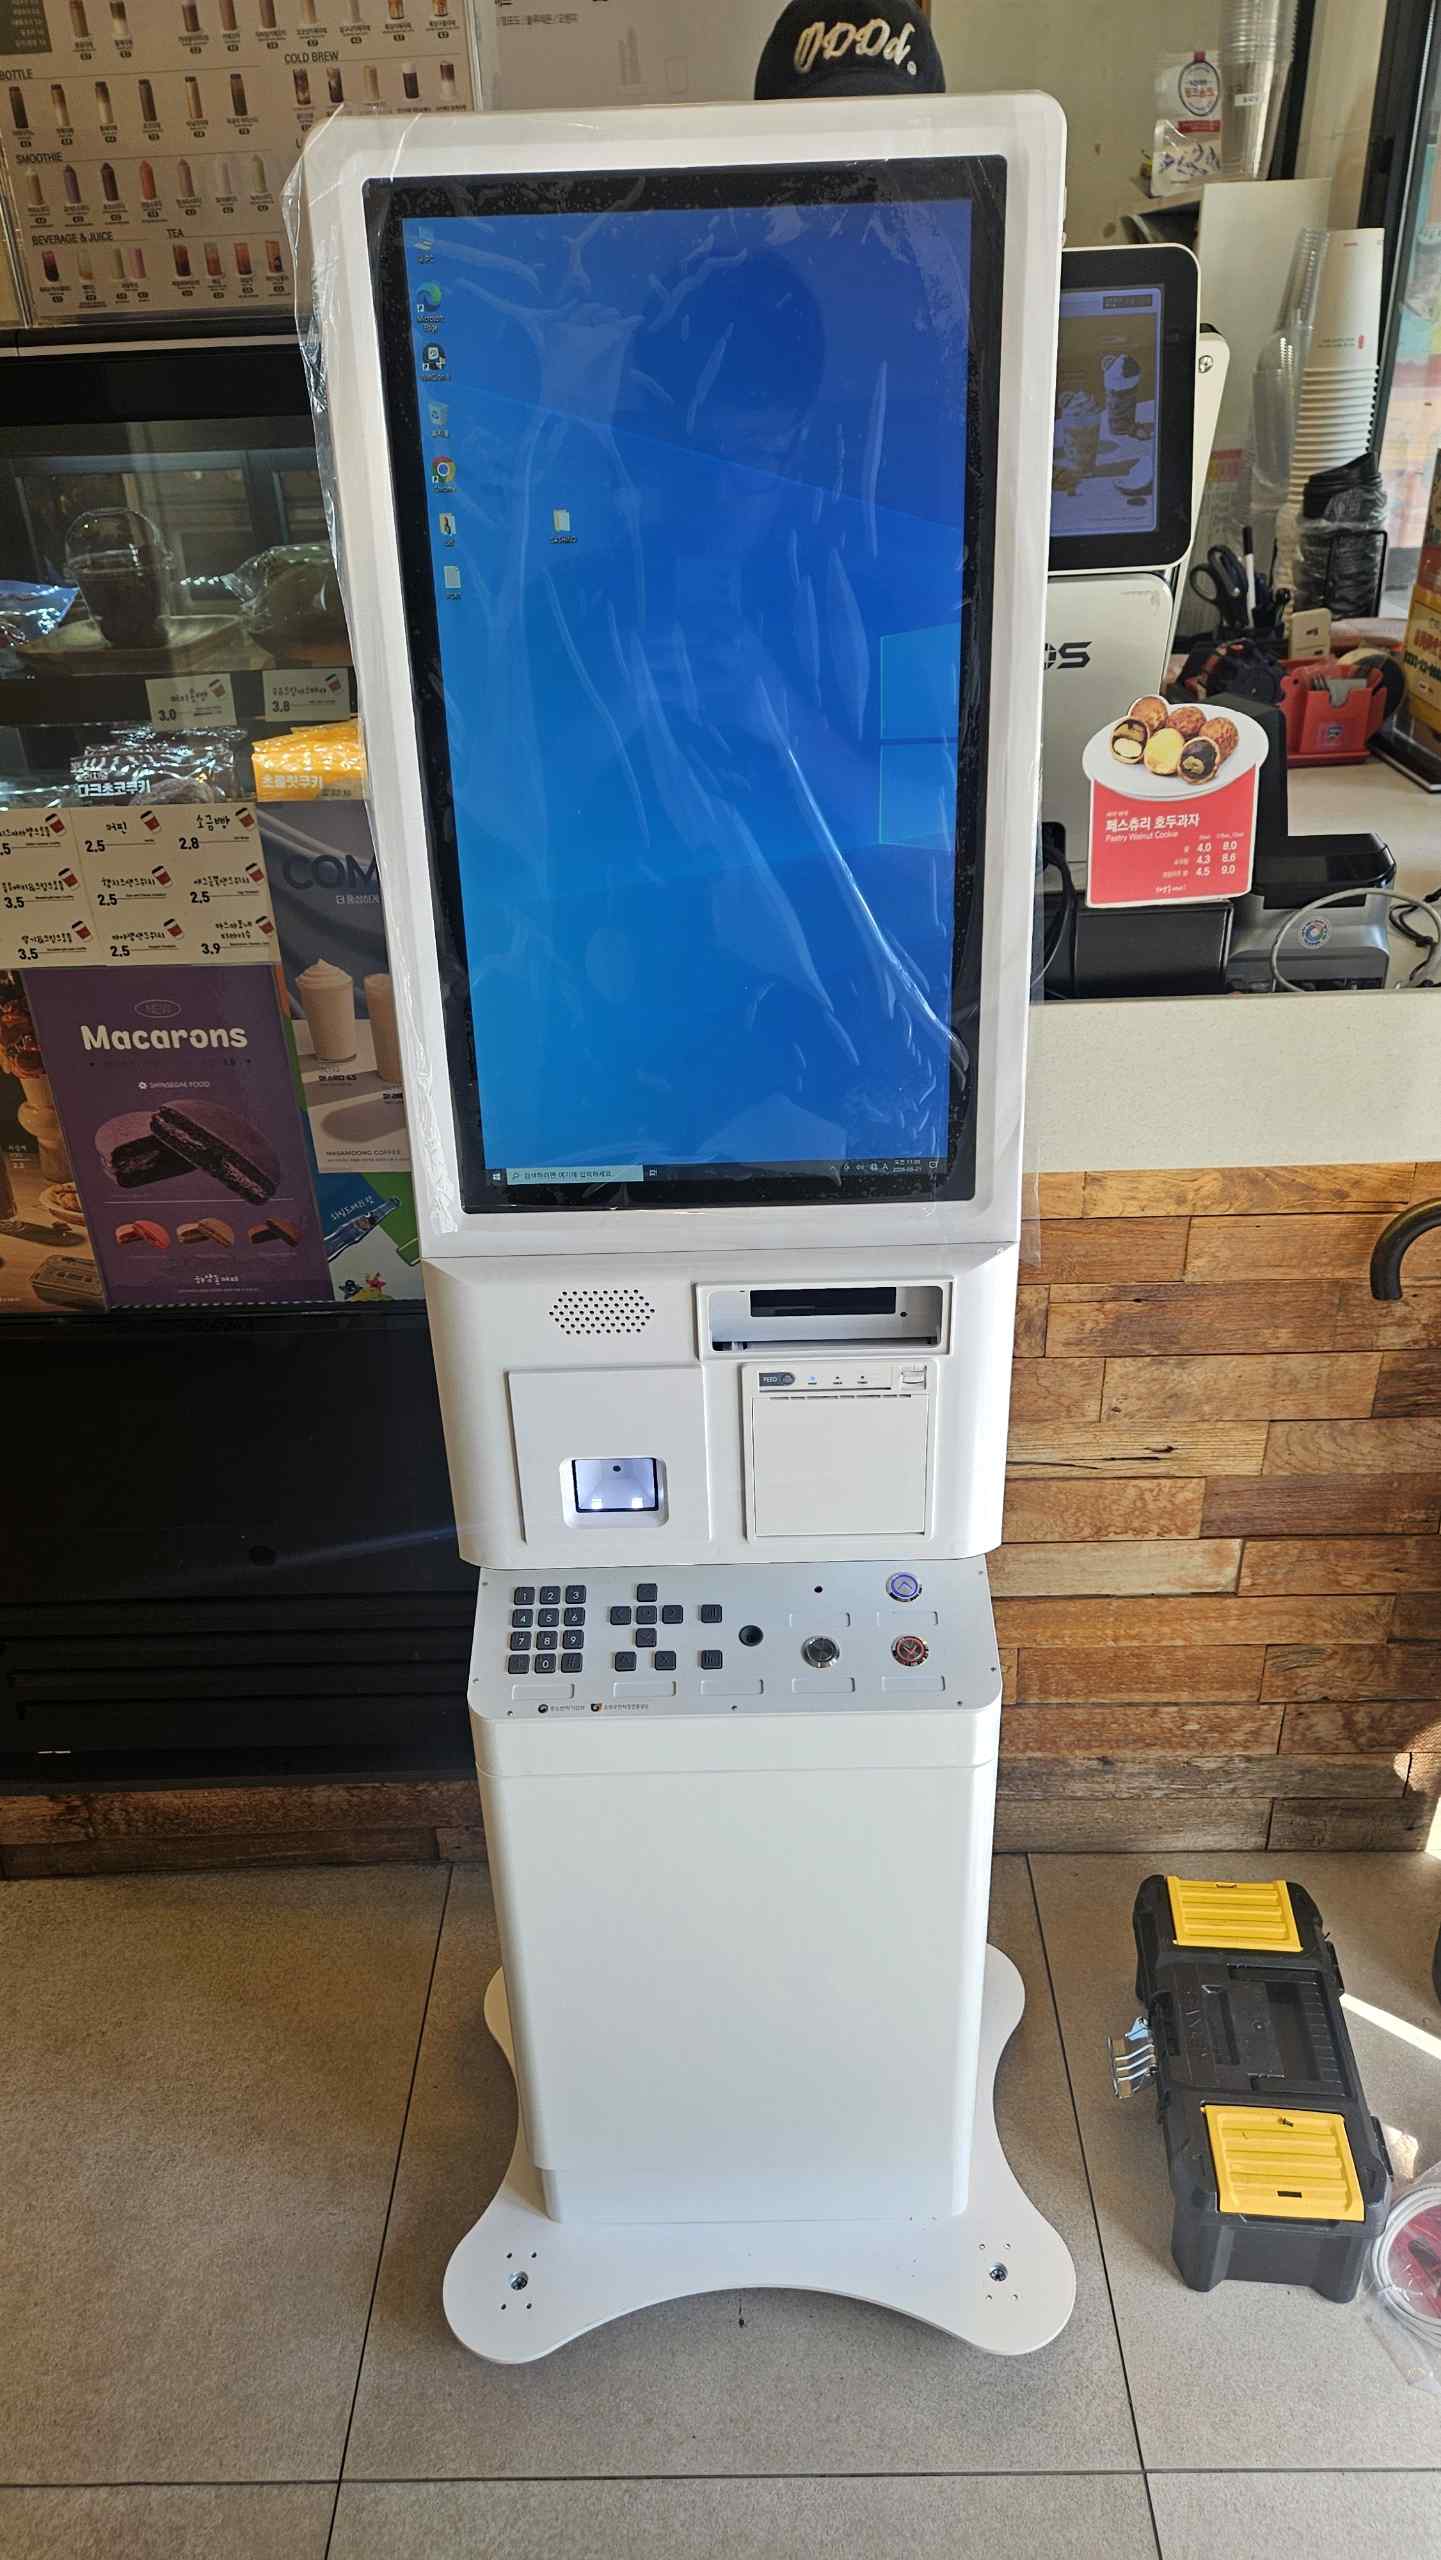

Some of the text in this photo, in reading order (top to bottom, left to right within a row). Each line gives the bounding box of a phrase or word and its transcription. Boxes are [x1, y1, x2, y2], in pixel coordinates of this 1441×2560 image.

[284, 51, 340, 64] COLD BREW
[0, 68, 33, 81] BOTTLE
[16, 152, 64, 165] SMOOTHIE
[32, 231, 113, 246] BEVERAGE & JUICE
[167, 229, 185, 239] TEA
[158, 709, 177, 721] 3.0
[79, 780, 151, 797] 다크초코쿠키
[196, 814, 230, 832] 소금빵
[1154, 812, 1200, 829] 호두과자
[178, 837, 200, 850] 2.8
[1105, 833, 1128, 844] Pastry
[84, 840, 106, 853] 2.5
[1196, 840, 1238, 853] 4.0 8.0
[1195, 854, 1211, 865] 4.3
[1195, 864, 1236, 877] 4.5 9.0
[4, 896, 25, 909] 3.5
[97, 893, 118, 906] 2.5
[190, 891, 210, 904] 2.5
[17, 948, 39, 960] 3.5
[110, 945, 131, 957] 2.5
[201, 943, 221, 955] 3.9
[80, 1024, 248, 1051] Macarons
[547, 1592, 554, 1600] 2
[572, 1591, 579, 1599] 3
[520, 1615, 526, 1623] 4
[546, 1614, 552, 1622] 5
[519, 1636, 576, 1646] 7 8 9
[542, 1660, 549, 1668] 0
